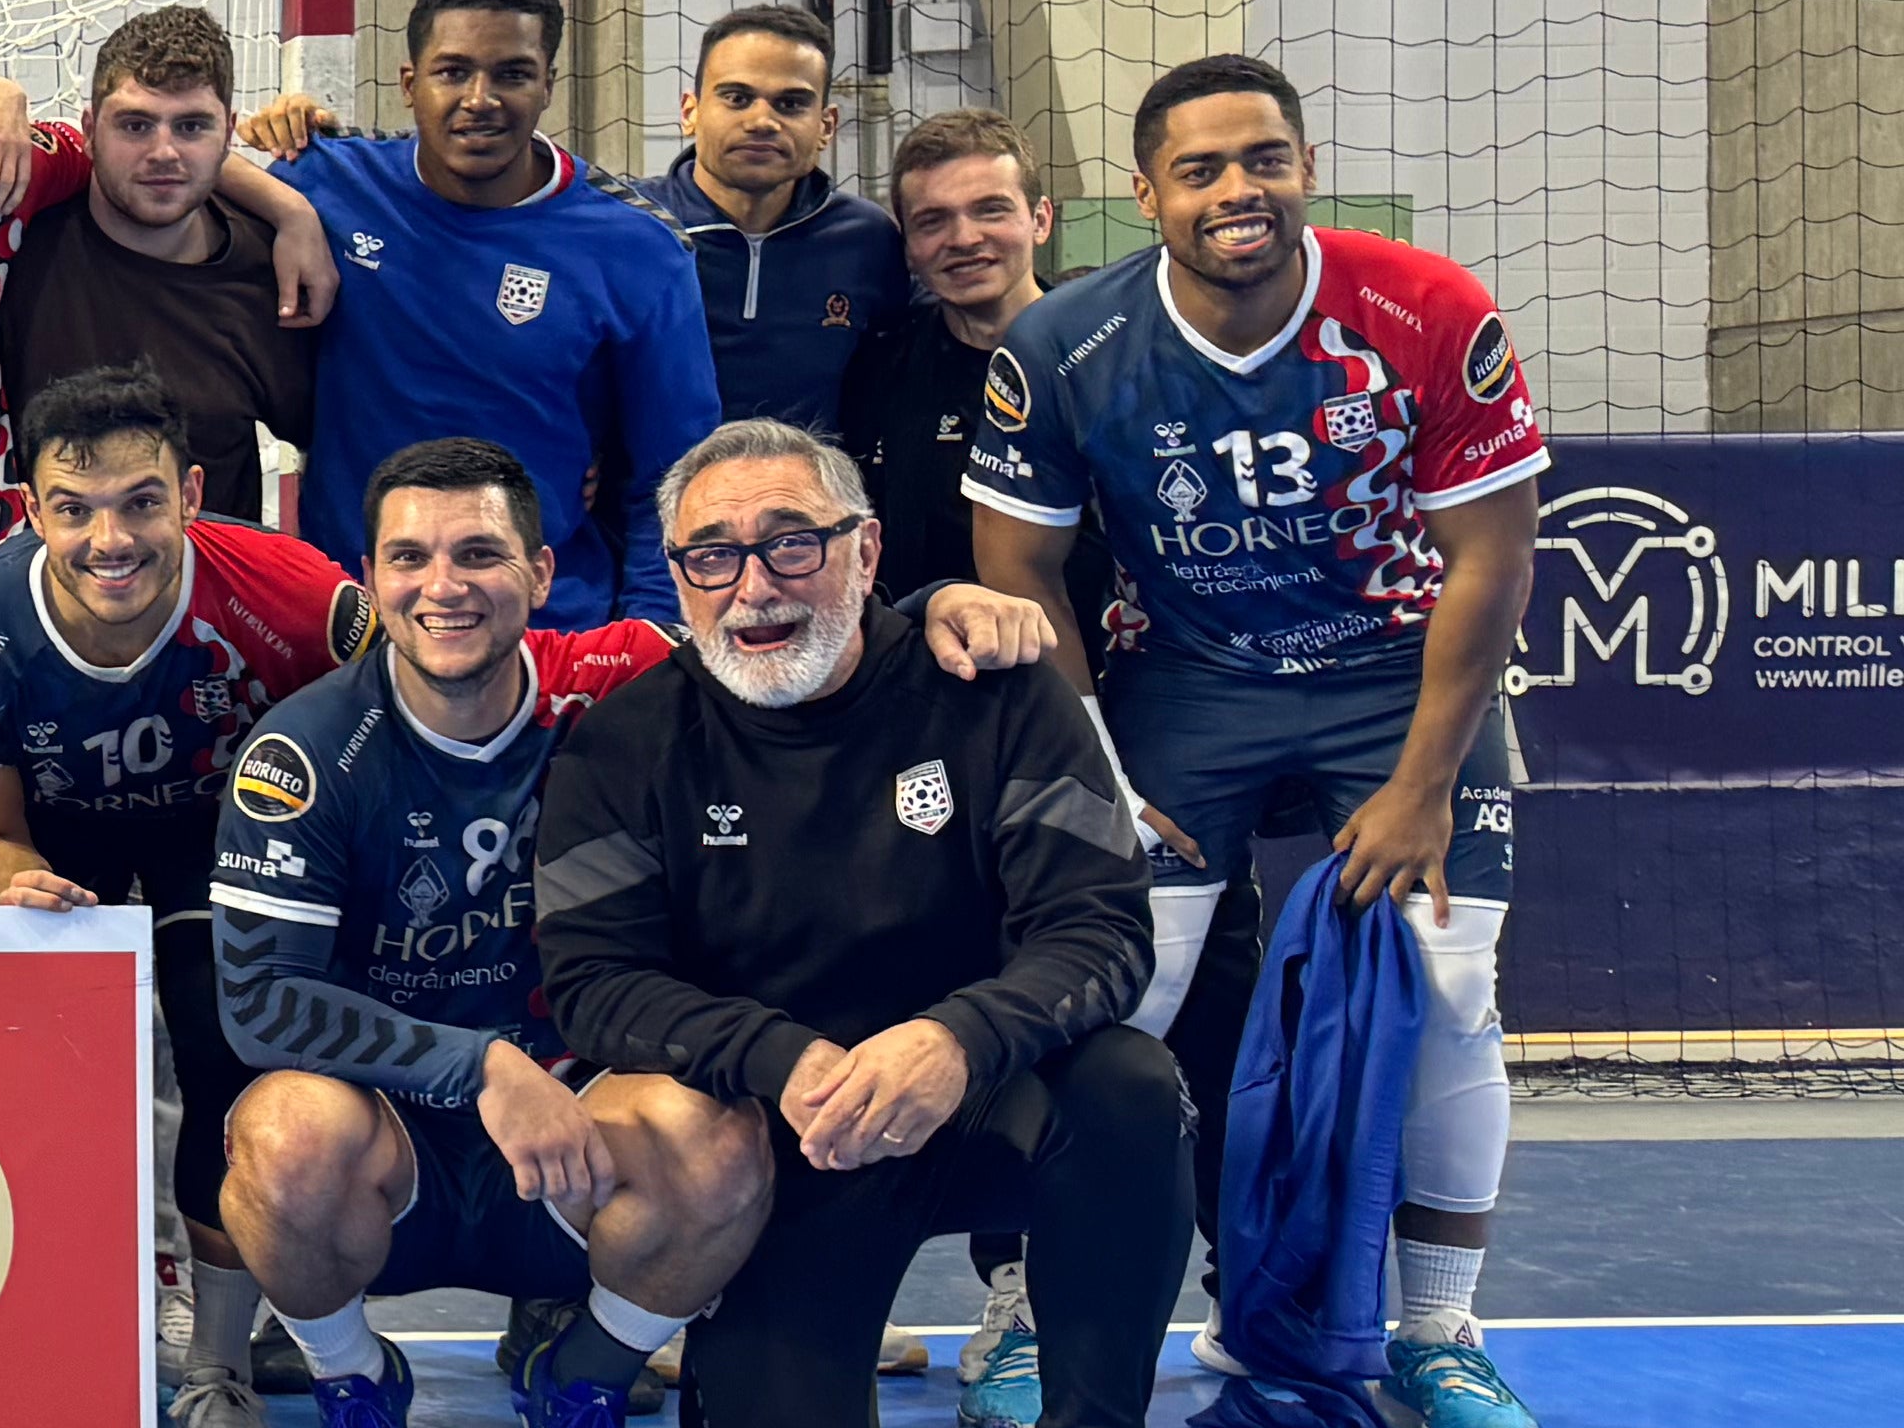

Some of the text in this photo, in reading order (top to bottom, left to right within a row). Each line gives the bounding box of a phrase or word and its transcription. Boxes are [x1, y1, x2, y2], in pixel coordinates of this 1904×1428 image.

[1463, 422, 1527, 462] suma
[1212, 429, 1318, 508] 13
[1150, 504, 1372, 557] HORNEO
[1753, 635, 1891, 659] CONTROL
[82, 714, 174, 788] 10
[217, 851, 278, 878] suma
